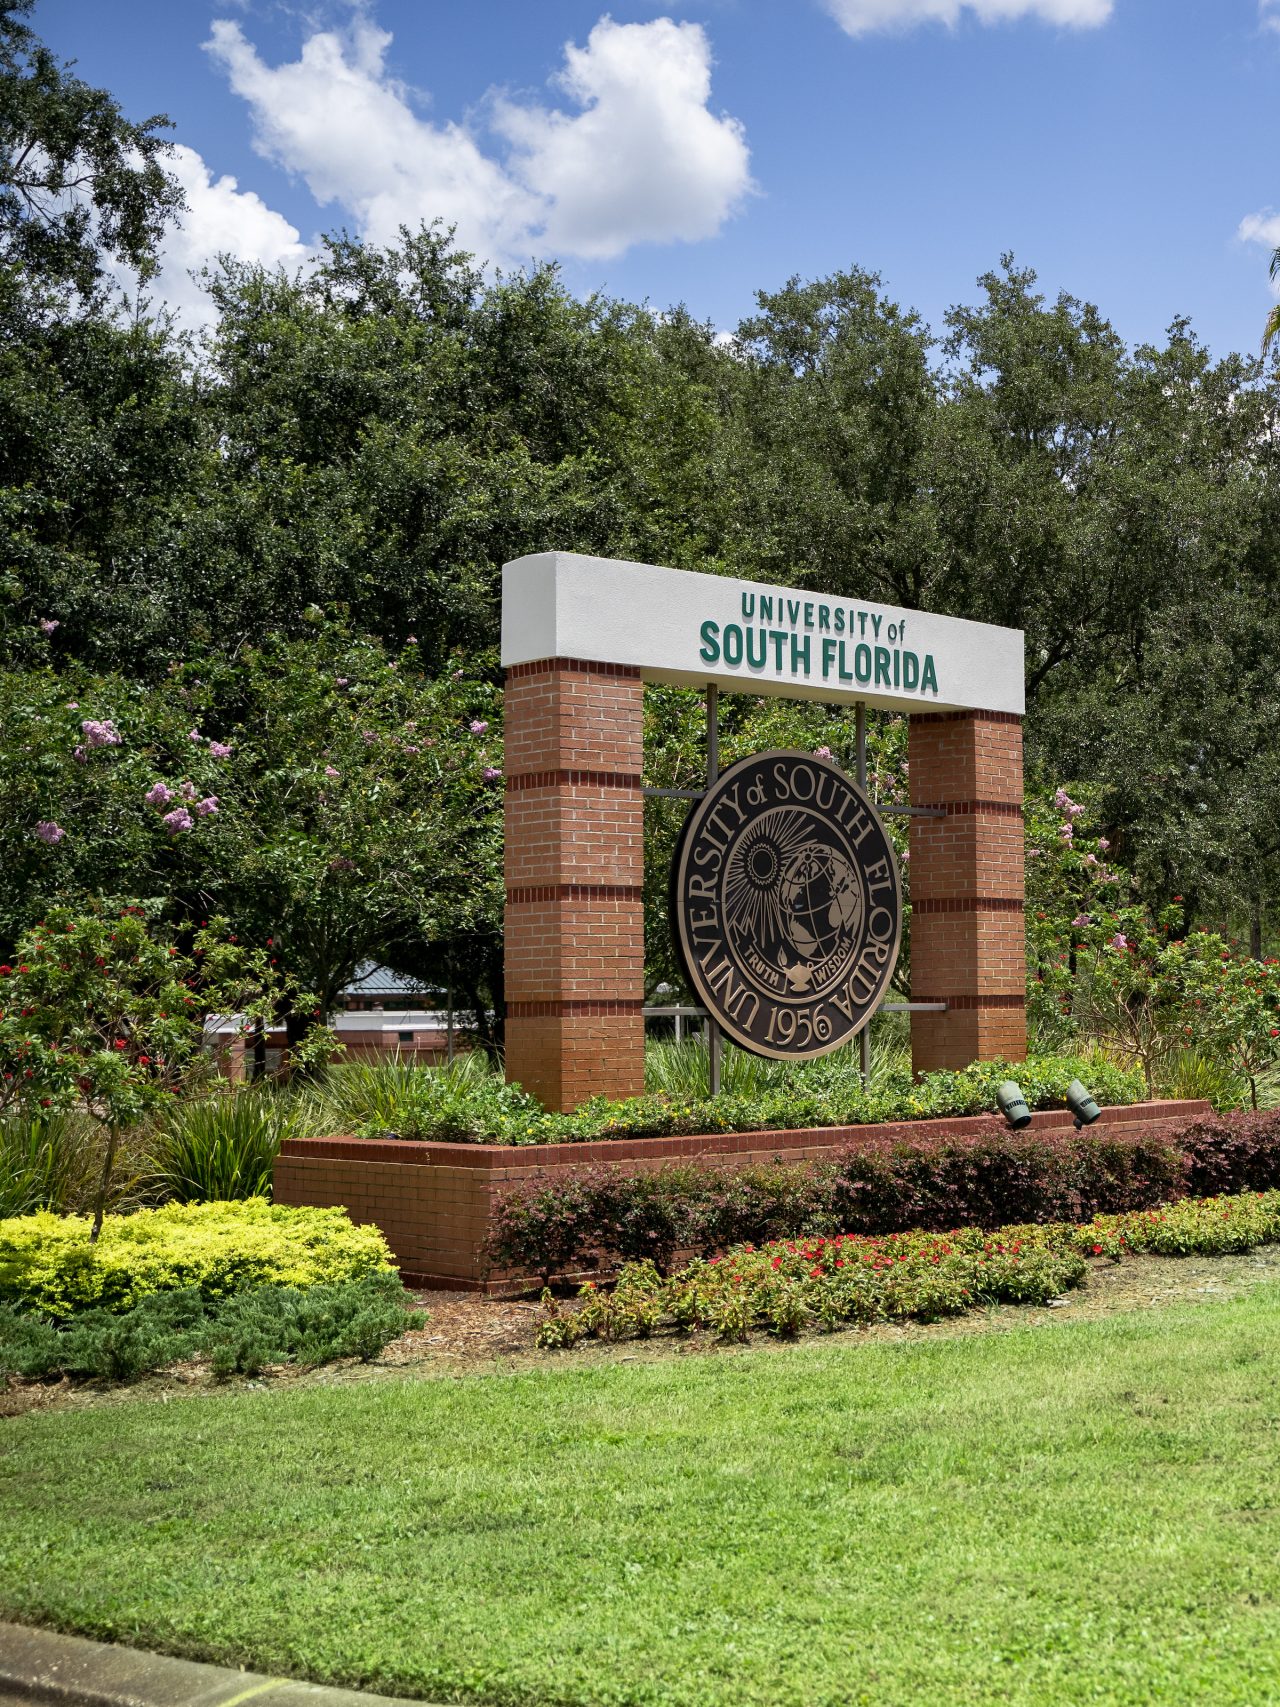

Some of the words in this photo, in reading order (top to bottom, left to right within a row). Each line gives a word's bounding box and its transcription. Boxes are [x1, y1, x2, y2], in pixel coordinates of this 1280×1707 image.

[741, 591, 883, 638] UNIVERSITY
[887, 619, 906, 642] of
[700, 620, 811, 674] SOUTH
[822, 637, 939, 693] FLORIDA
[687, 784, 760, 1033] UNIVERSITY
[746, 773, 767, 806] of
[773, 763, 874, 850] SOUTH
[828, 854, 893, 1022] FLORIDA
[743, 944, 780, 987] TRUTH
[813, 936, 852, 984] WISDOM
[763, 1003, 833, 1048] 1956
